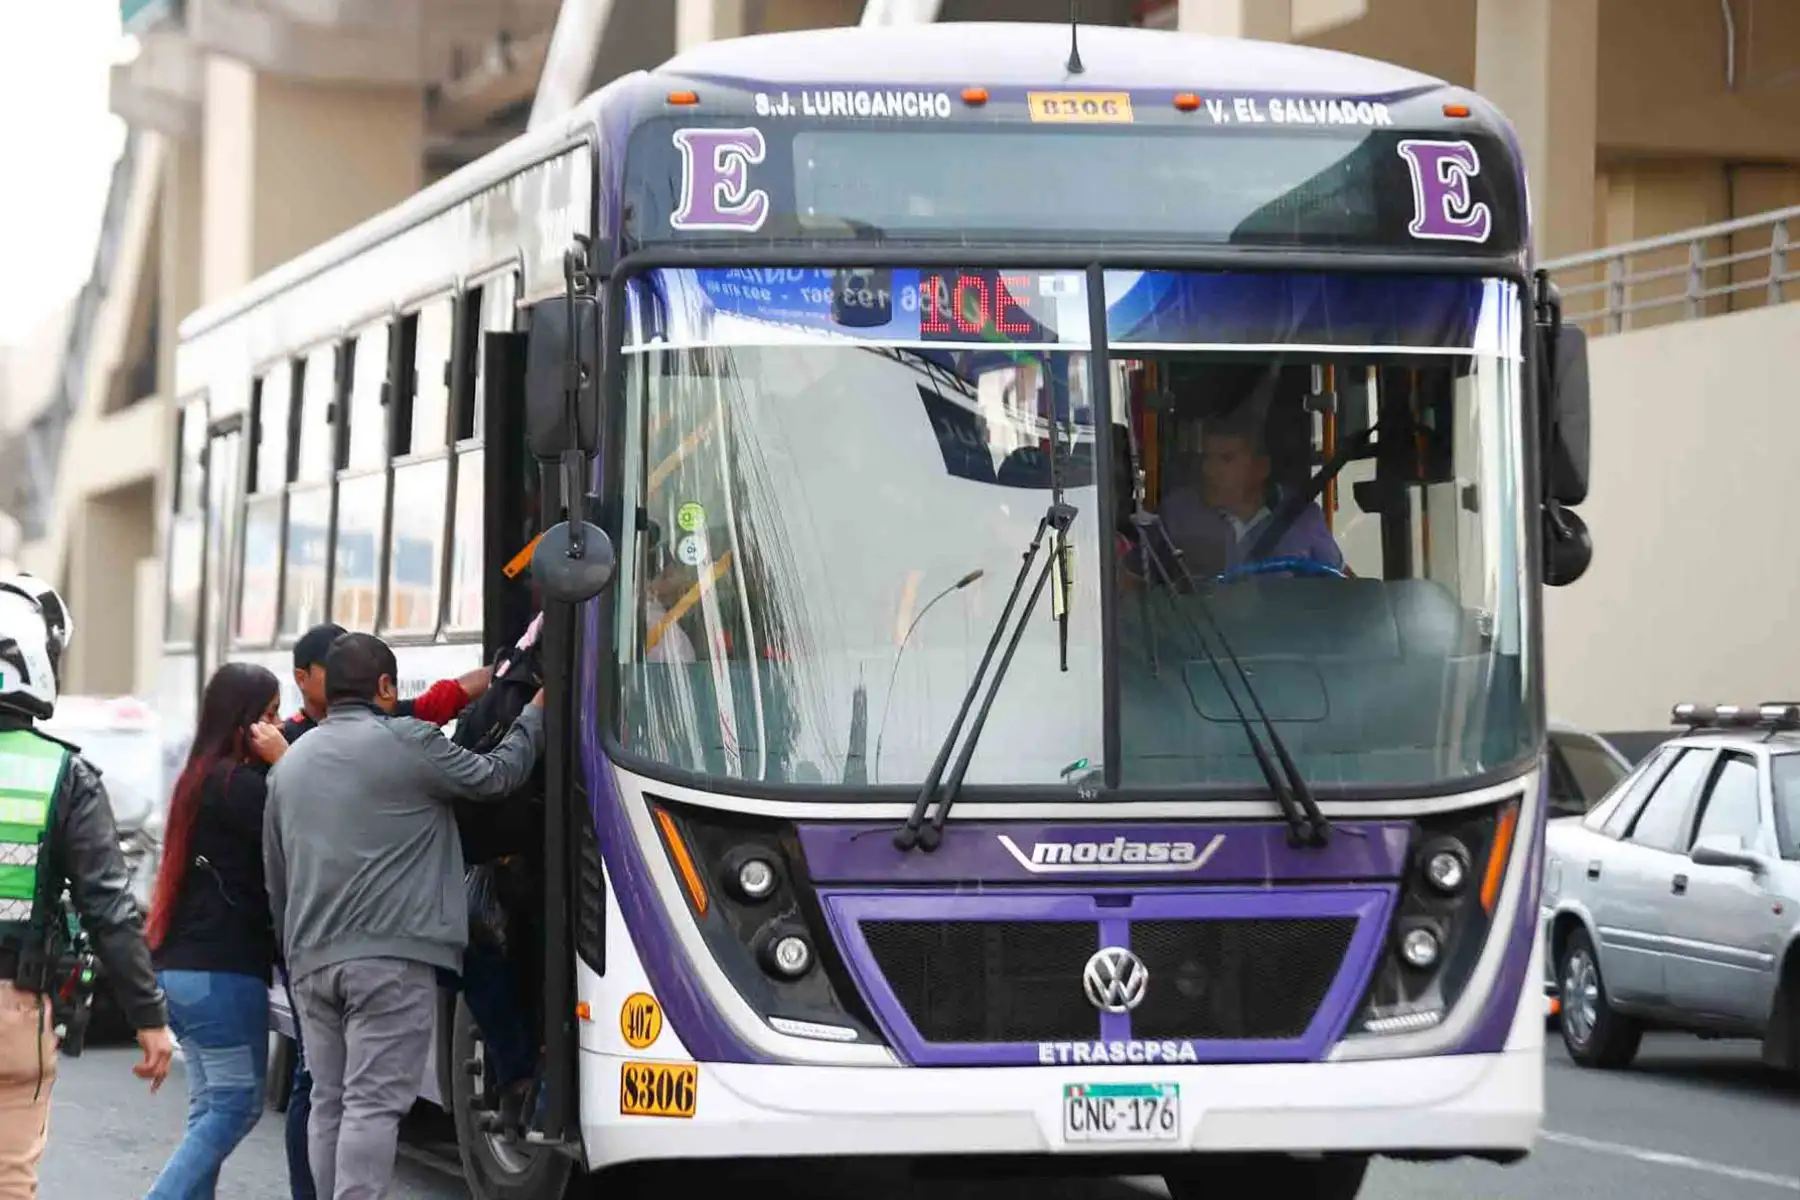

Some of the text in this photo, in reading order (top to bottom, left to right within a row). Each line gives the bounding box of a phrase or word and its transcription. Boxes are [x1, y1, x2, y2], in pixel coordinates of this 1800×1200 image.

[755, 91, 951, 117] S.J. LURIGANCHO
[1205, 98, 1394, 125] V. EL SALVADOR
[670, 127, 769, 232] E
[1397, 139, 1492, 243] E
[1032, 837, 1196, 863] modasa
[627, 1003, 654, 1040] 407
[1039, 1042, 1199, 1064] ETRASCPSA
[623, 1066, 694, 1112] 8306
[1070, 1097, 1174, 1131] CNC-176
